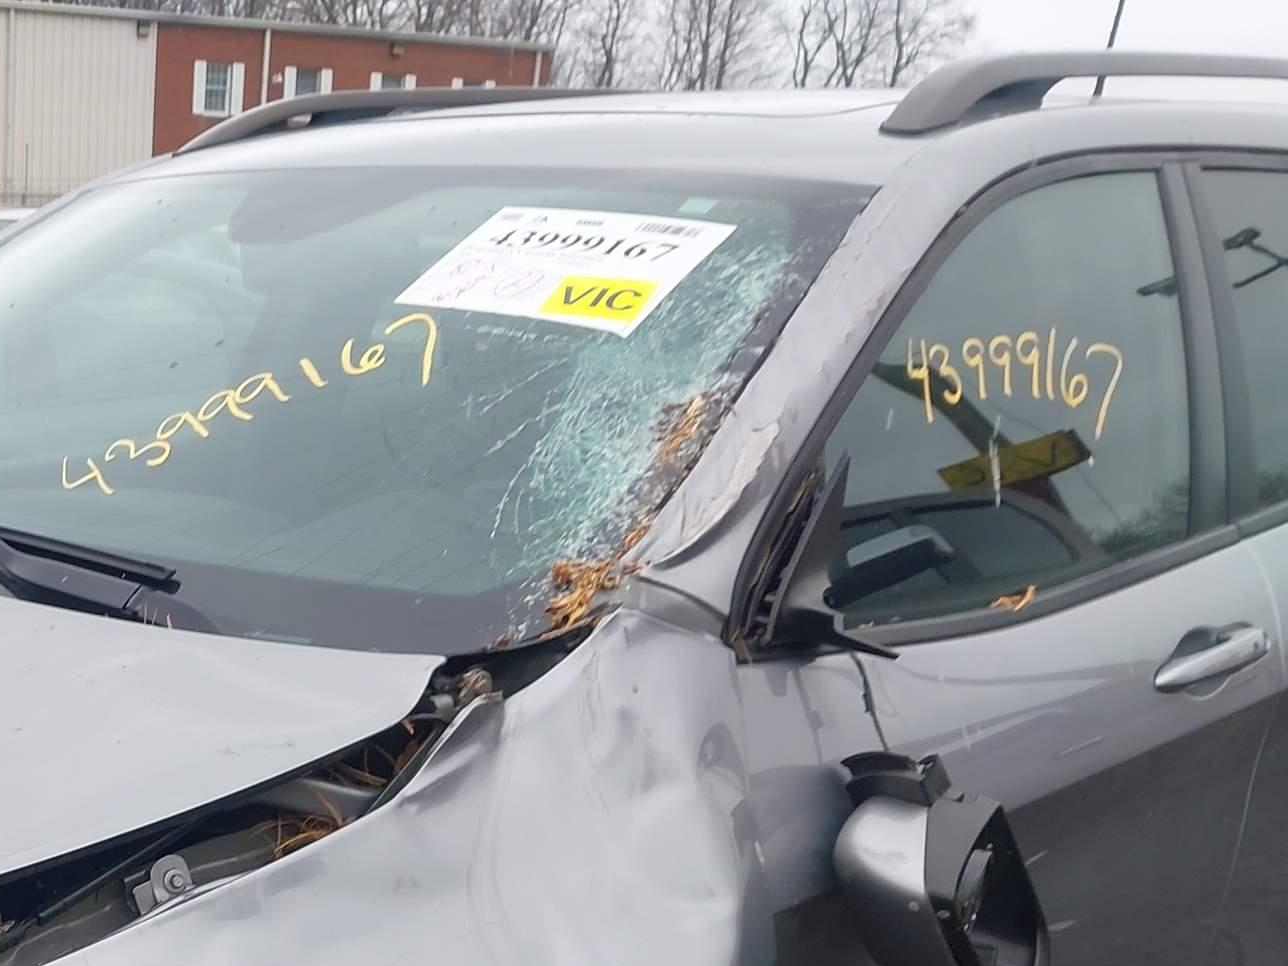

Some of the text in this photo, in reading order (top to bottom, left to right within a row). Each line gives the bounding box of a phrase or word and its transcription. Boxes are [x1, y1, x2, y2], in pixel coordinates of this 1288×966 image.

[489, 228, 681, 262] 43999167
[562, 285, 642, 312] VIC
[62, 312, 438, 495] 43999167
[907, 324, 1123, 441] 43999167
